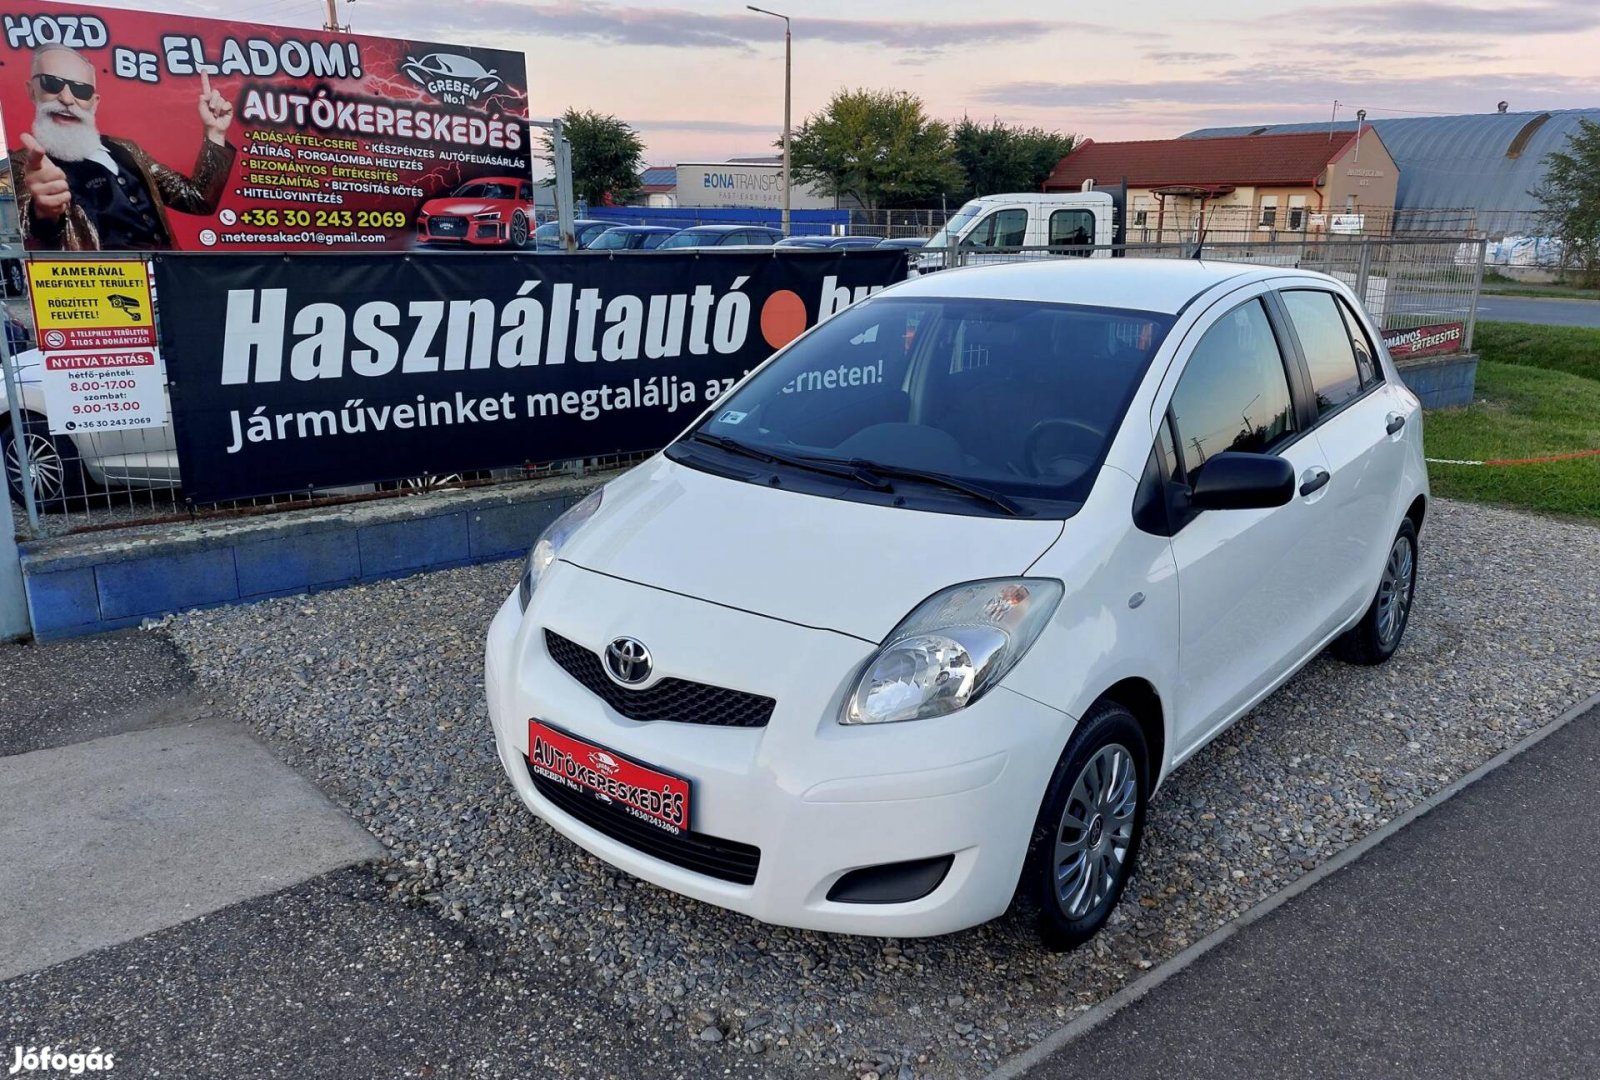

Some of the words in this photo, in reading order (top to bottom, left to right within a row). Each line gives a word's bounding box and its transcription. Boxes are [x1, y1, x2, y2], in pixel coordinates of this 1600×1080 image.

[4, 16, 108, 48] HOZD
[163, 36, 362, 77] ELADOM!
[115, 48, 159, 82] BE
[427, 79, 480, 100] GREBEN
[443, 93, 466, 105] No.1
[243, 90, 522, 150] AUTÓKERESKEDÉS
[252, 130, 358, 150] ADÁS-VÉTEL-CSERE
[250, 143, 294, 159] ÁTÍRÁS,
[298, 150, 373, 166] FORGALOMBA
[375, 158, 423, 171] HELYEZÉS
[372, 143, 435, 159] KÉSZPÉNZES
[439, 151, 525, 169] AUTÓFELVÁSÁRLÁS
[249, 160, 328, 175] BIZOMÁNYOS
[332, 167, 398, 182] ÉRTÉKESÍTÉS
[250, 174, 320, 188] BESZÁMÍTÁS
[332, 181, 391, 195] BIZTOSÍTÁS
[392, 186, 423, 197] KÖTÉS
[243, 188, 343, 204] HITELÜGYINTÉZÉS
[240, 209, 279, 226] +36
[283, 210, 311, 226] 30
[315, 211, 353, 227] 243
[357, 211, 406, 228] 2069
[52, 265, 125, 277] KAMERÁVAL
[36, 279, 95, 288] MEGFIGYELT
[100, 278, 144, 288] TERÜLET!
[48, 297, 98, 308] RÖGZÍTETT
[51, 309, 99, 320] FELVÉTEL!
[52, 357, 100, 368] NYITVA
[100, 353, 149, 365] TARTÁS:
[68, 368, 135, 380] hétfő-péntek:
[70, 379, 136, 392] 8.00-17.00
[84, 392, 127, 401] szombat:
[72, 401, 140, 414] 9.00-13.00
[226, 390, 516, 454] Járműveinket
[527, 375, 696, 421] megtalálja
[704, 378, 735, 400] az
[129, 417, 151, 425] 2069
[533, 765, 566, 785] GREBEN
[566, 781, 583, 793] No.1
[533, 735, 683, 825] AUTÓKERESKEDÉS
